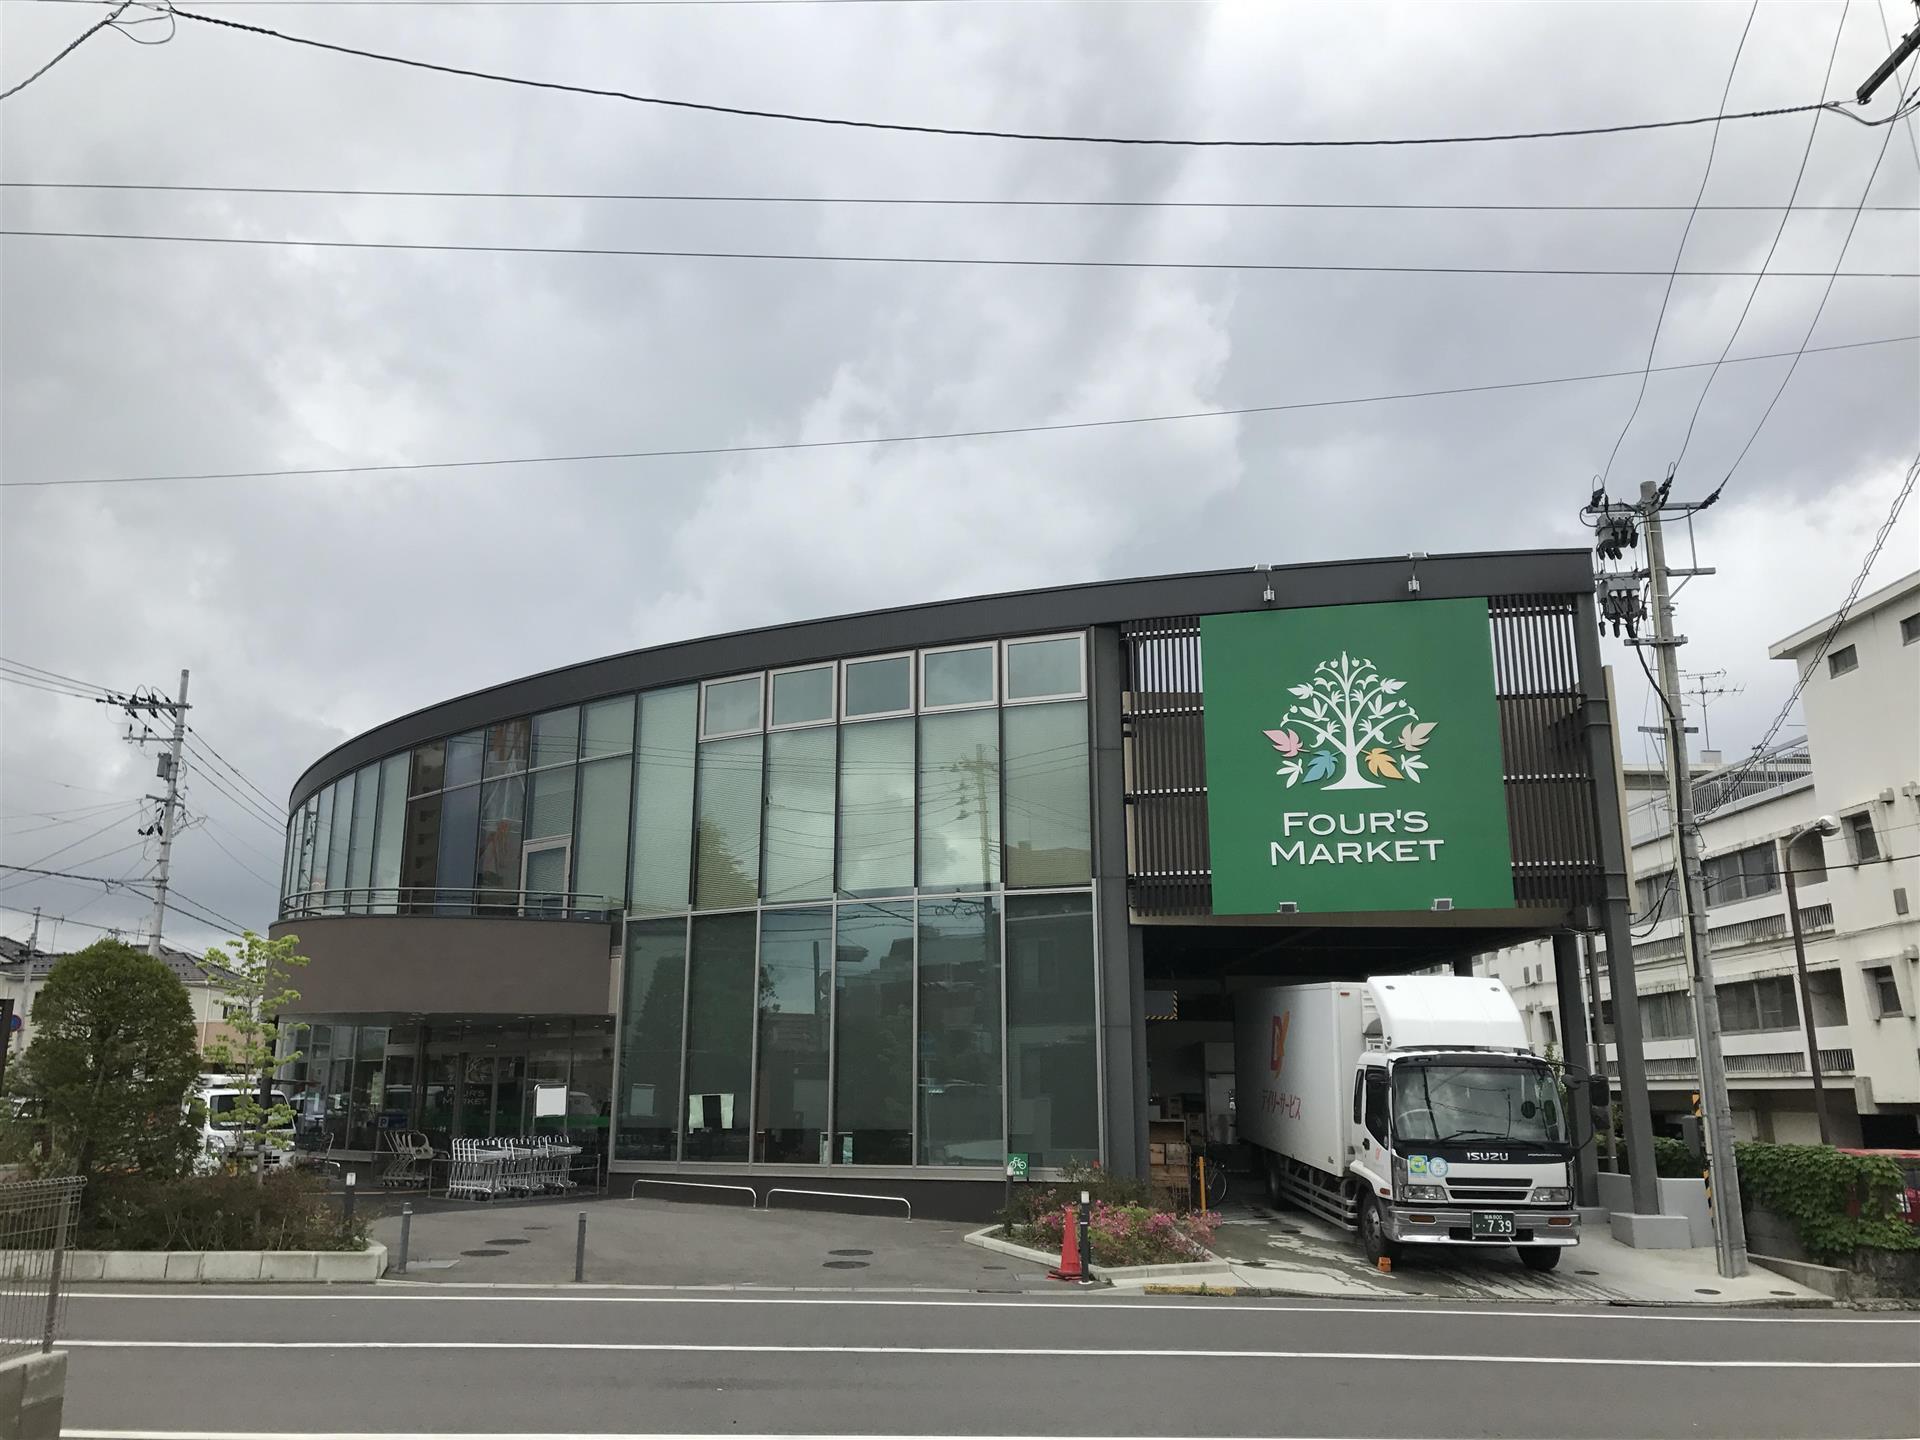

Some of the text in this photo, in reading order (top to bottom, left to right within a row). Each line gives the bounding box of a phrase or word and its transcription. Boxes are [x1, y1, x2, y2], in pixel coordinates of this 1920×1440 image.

[1283, 809, 1429, 837] FOUR'S
[1270, 839, 1445, 866] MARKET
[1466, 1152, 1509, 1161] ISUZU
